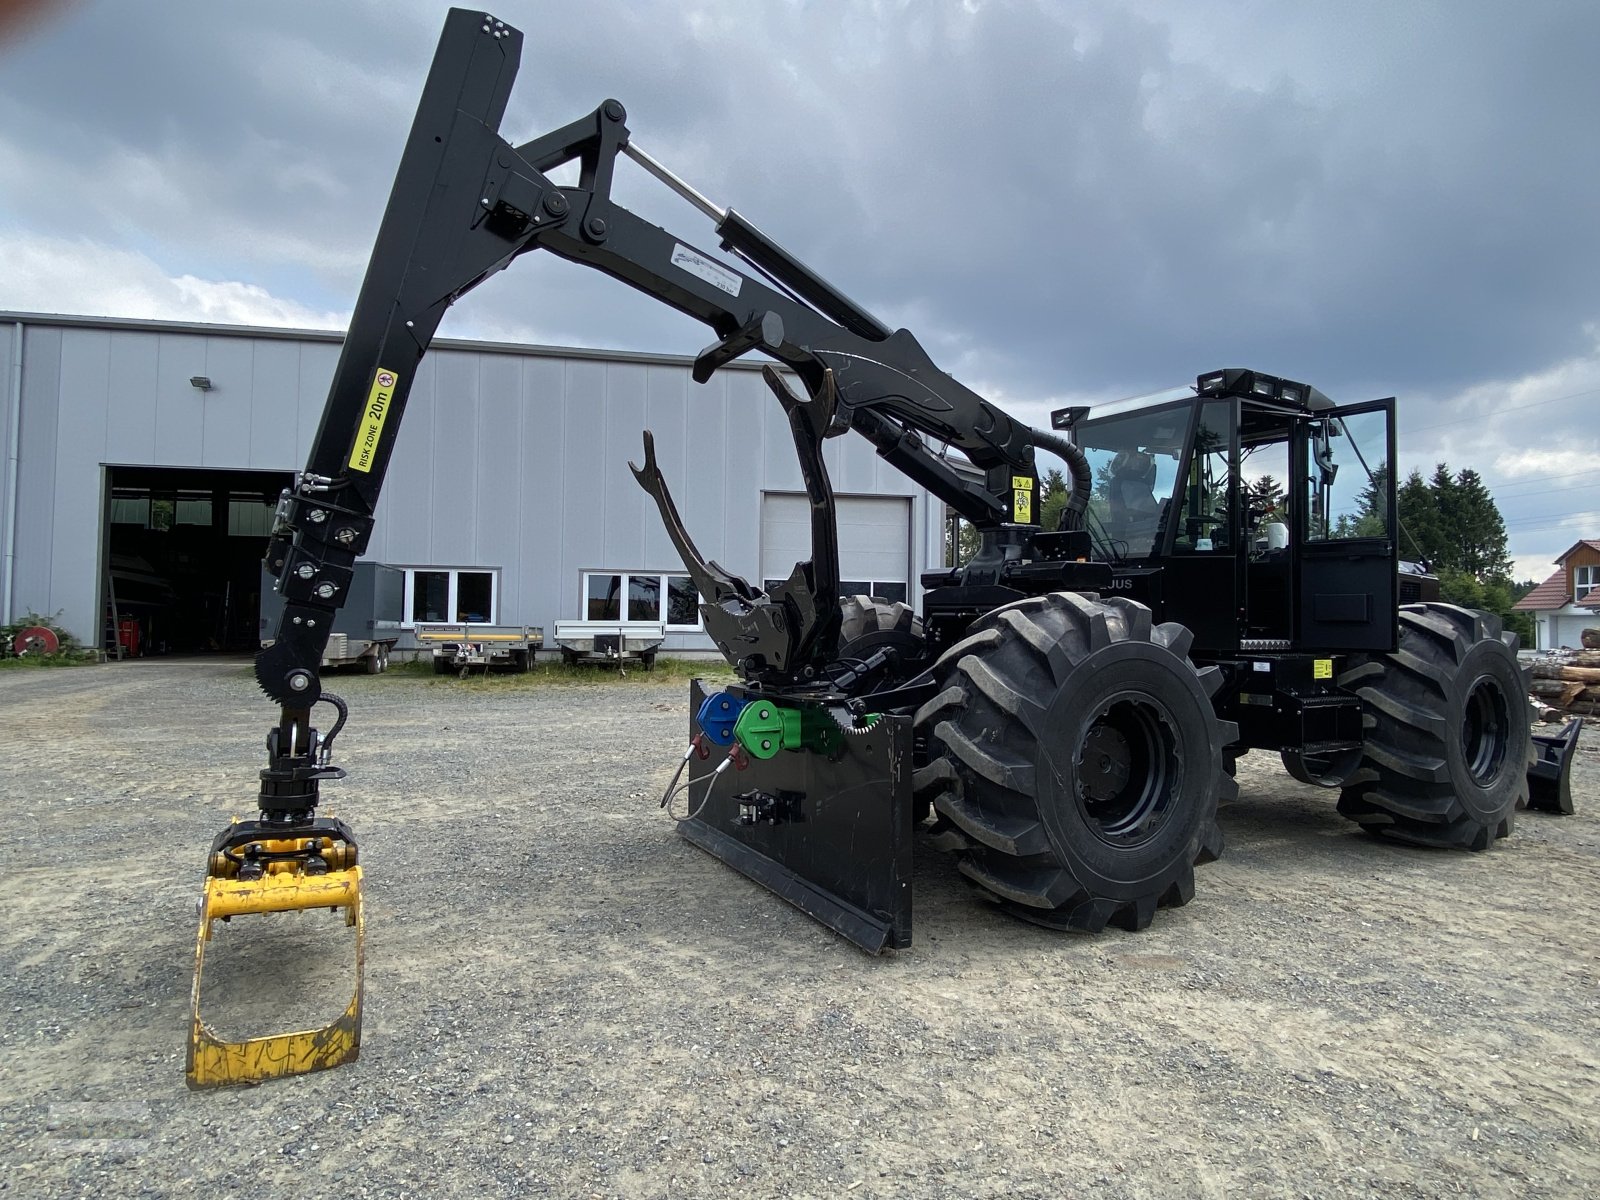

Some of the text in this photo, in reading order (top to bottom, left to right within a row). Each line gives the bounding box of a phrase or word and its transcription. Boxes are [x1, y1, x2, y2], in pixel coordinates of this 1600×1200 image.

[359, 392, 388, 467] RISK ZONE 20m
[1100, 579, 1132, 590] JUS
